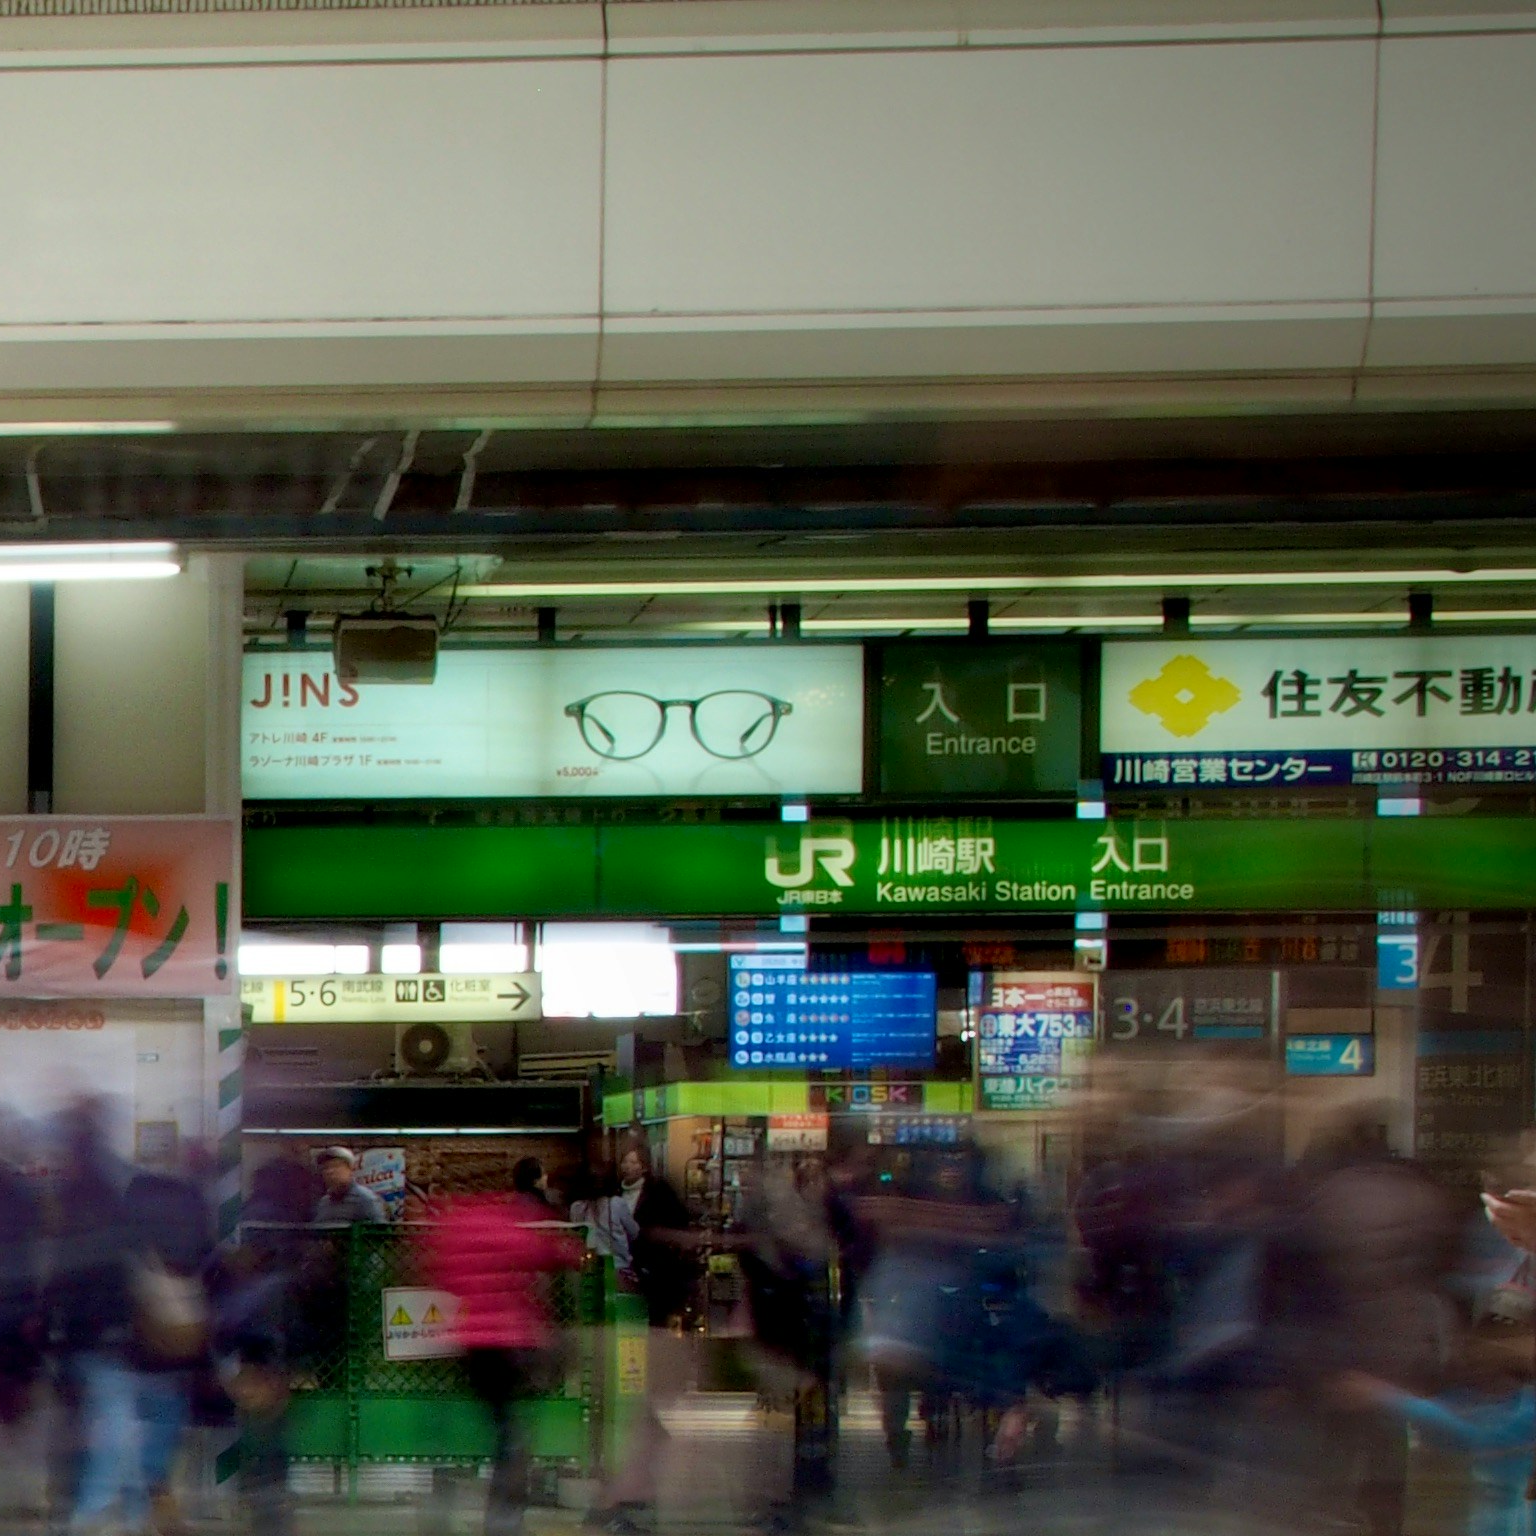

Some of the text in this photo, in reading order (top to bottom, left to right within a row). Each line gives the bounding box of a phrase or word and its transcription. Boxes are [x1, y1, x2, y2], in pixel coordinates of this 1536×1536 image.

[915, 682, 1047, 725] 入口
[1262, 666, 1536, 718] 住友不動
[312, 732, 328, 744] 4F
[926, 731, 1037, 756] Entrance
[1114, 757, 1333, 785] 川崎営業センター
[4, 827, 111, 871] 10時
[764, 834, 856, 888] JR
[877, 835, 1169, 876] 川崎駅 入口
[777, 890, 844, 905] JR東日本
[877, 880, 1194, 902] Kawasaki Station Entrance
[1339, 1038, 1364, 1071] 4
[825, 1086, 908, 1103] KIOSK
